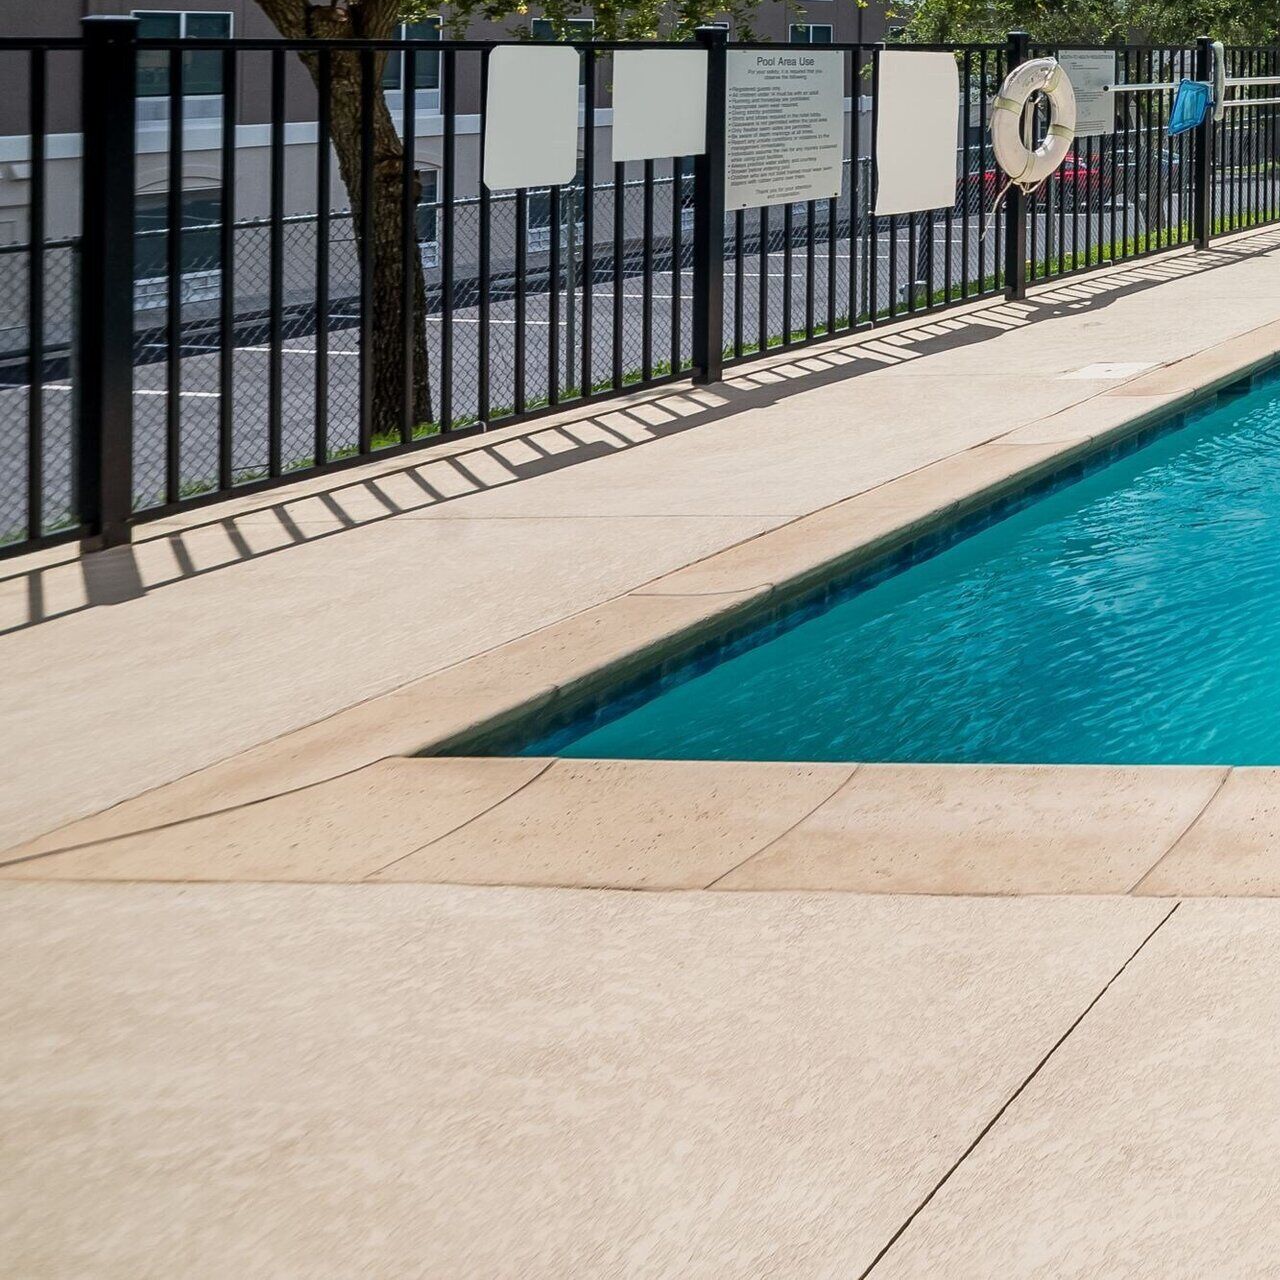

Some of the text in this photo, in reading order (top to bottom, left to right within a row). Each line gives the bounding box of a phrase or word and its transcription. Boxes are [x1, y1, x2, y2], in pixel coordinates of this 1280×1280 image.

[757, 57, 815, 66] Pool Area Use
